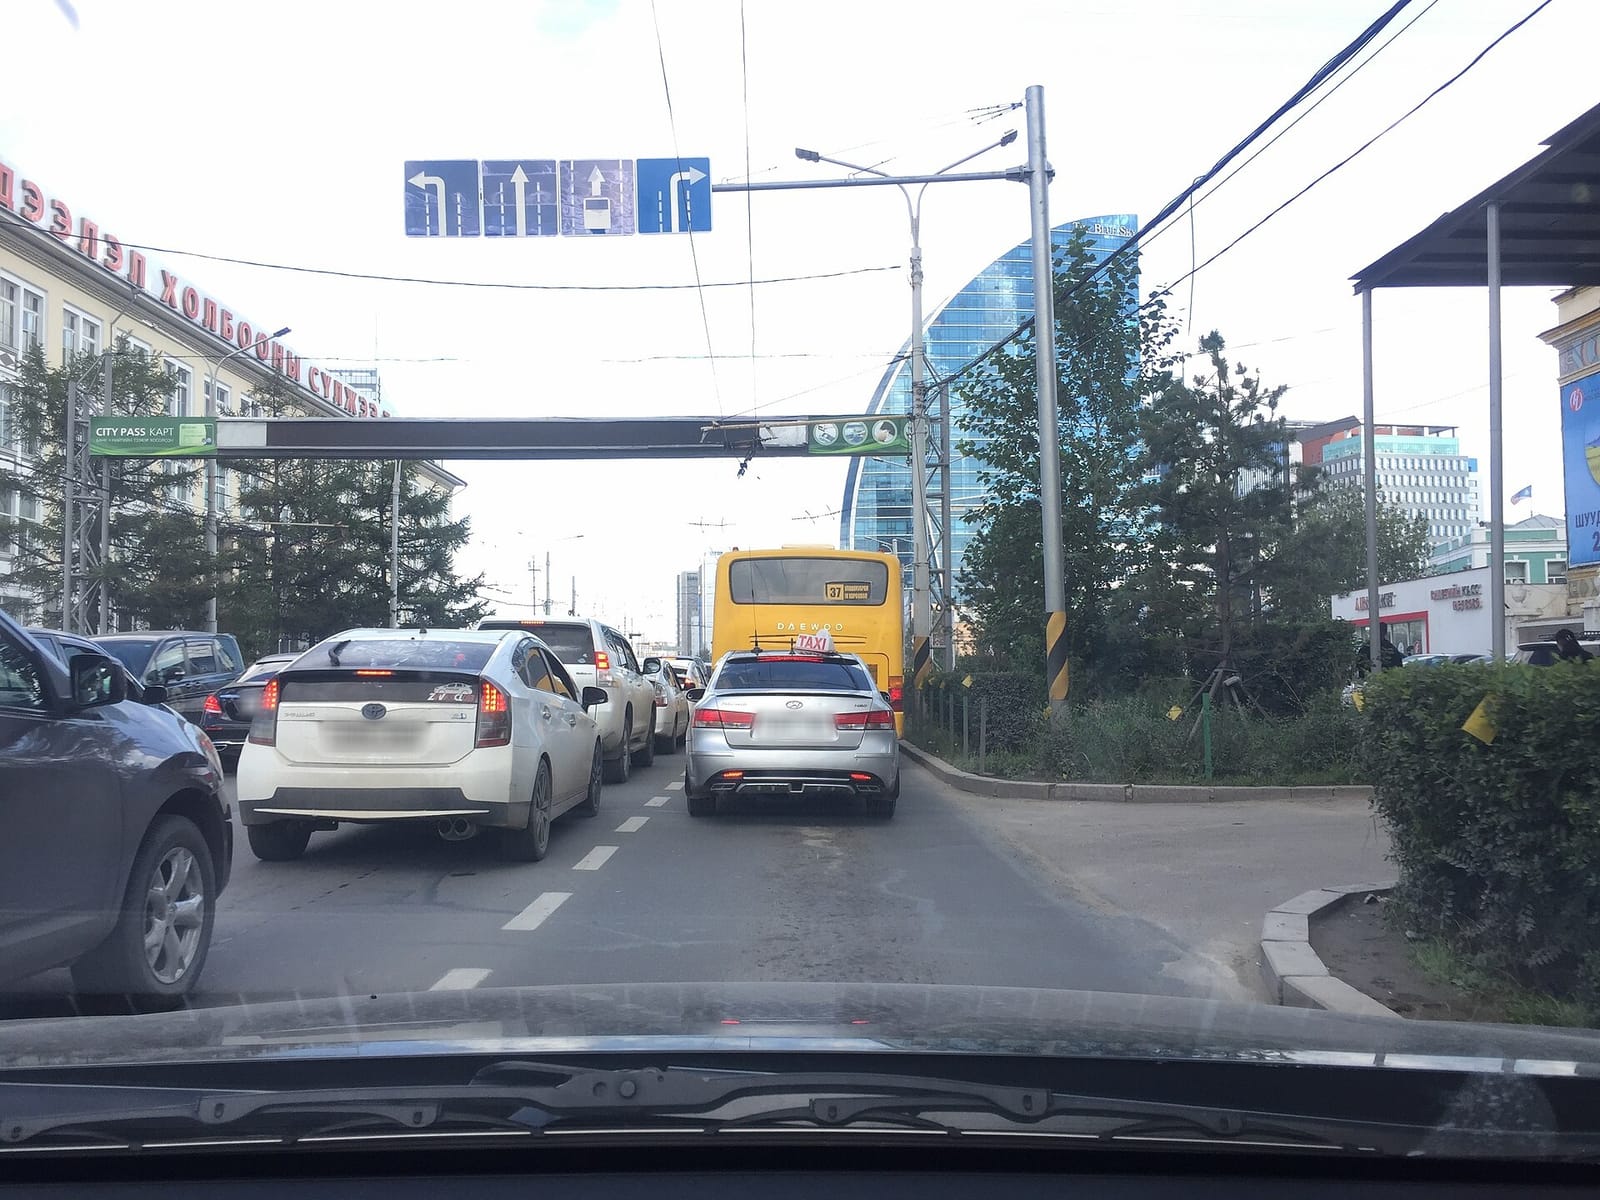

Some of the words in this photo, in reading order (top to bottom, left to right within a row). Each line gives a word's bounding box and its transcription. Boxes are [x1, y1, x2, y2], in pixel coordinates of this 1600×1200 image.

[160, 269, 301, 382] ХОЛБООНЫ
[96, 427, 118, 437] CITY
[120, 427, 146, 437] PASS
[149, 427, 174, 437] КАРТ
[830, 587, 841, 598] 37
[777, 623, 843, 631] DAEWOO
[799, 635, 827, 651] TAXI
